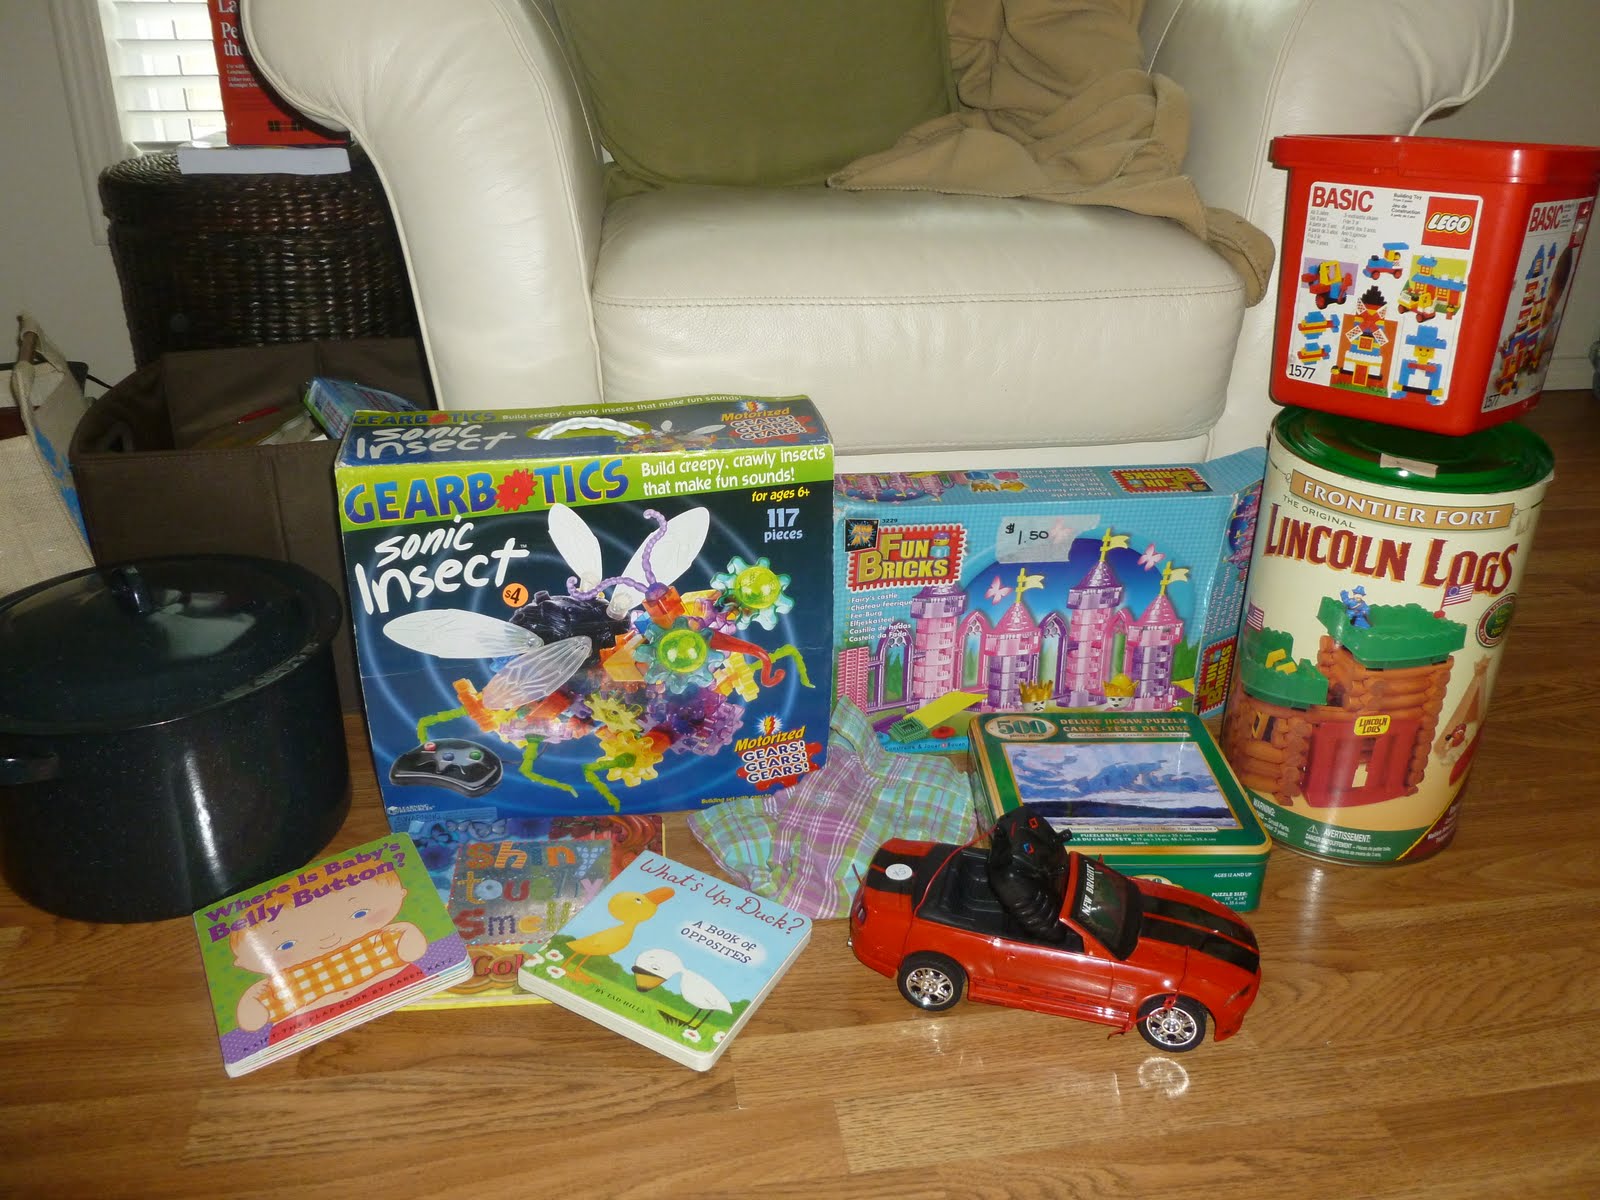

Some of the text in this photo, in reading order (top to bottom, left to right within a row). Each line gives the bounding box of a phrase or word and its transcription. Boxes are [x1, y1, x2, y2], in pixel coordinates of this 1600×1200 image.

[1311, 186, 1374, 212] BASIC
[1427, 212, 1473, 234] LEGO
[1528, 204, 1564, 232] BASIC
[1288, 363, 1316, 380] 1577
[567, 408, 599, 416] crawly
[601, 405, 635, 414] insects
[637, 402, 656, 410] that
[721, 407, 790, 422] Motorized
[730, 414, 795, 428] GEARS!
[735, 421, 801, 434] GEARS!
[740, 427, 807, 441] GEARS!
[356, 431, 517, 459] Insect
[641, 460, 675, 477] Build
[733, 451, 777, 468] crawly
[780, 445, 826, 463] insects
[643, 467, 796, 496] that make fun sounds!
[751, 486, 811, 502] for ages 6+
[1303, 481, 1500, 526] FRONTIER FORT
[766, 507, 800, 528] 117
[1283, 494, 1356, 529] THE ORIGINAL
[763, 529, 803, 543] pieces
[880, 533, 930, 560] FUN
[1264, 502, 1412, 581] LINCOLN
[1420, 537, 1518, 597] LOGS
[355, 537, 530, 616] Insect
[858, 550, 949, 582] BRICKS
[851, 595, 876, 604] Fairy's
[848, 634, 875, 643] Castelo
[849, 626, 876, 635] Castillo
[734, 725, 806, 753] Motorized
[996, 719, 1048, 735] 500
[741, 739, 805, 763] GEARS!
[744, 750, 808, 774] GEARS!
[746, 761, 809, 784] GEARS!
[1323, 828, 1372, 843] AVERTISSEMENT:
[205, 841, 401, 922] Where Is Baby's
[1081, 863, 1095, 916] NEW BRIGHT
[207, 852, 406, 943] Belly Button?
[640, 858, 704, 892] What's
[735, 896, 805, 935] Duck?
[693, 920, 703, 929] A
[705, 924, 741, 944] BOOK
[680, 927, 752, 964] OPPOSITES
[339, 993, 368, 1009] BOOK
[372, 986, 385, 994] BY
[389, 970, 424, 988] KAREN
